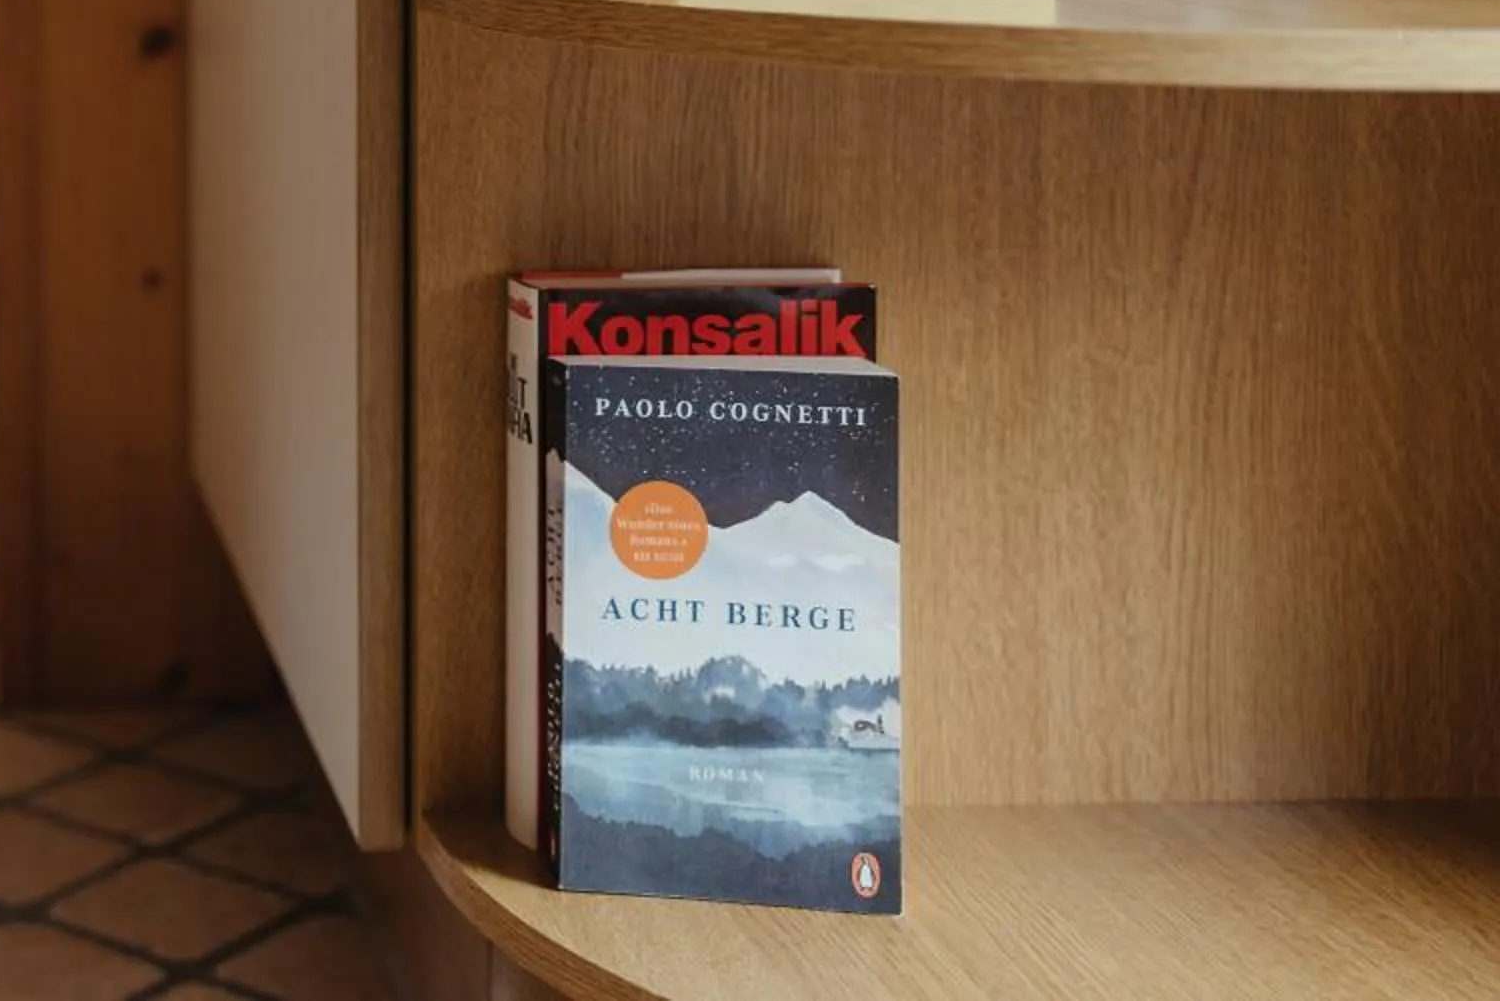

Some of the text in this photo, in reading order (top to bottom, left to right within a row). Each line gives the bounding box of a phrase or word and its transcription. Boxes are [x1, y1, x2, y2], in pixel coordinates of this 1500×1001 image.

[547, 298, 868, 358] Konsalik
[595, 398, 867, 427] PAOLO COGNETTI
[601, 596, 857, 632] ACHT BERGE
[689, 764, 765, 784] ROMAN
